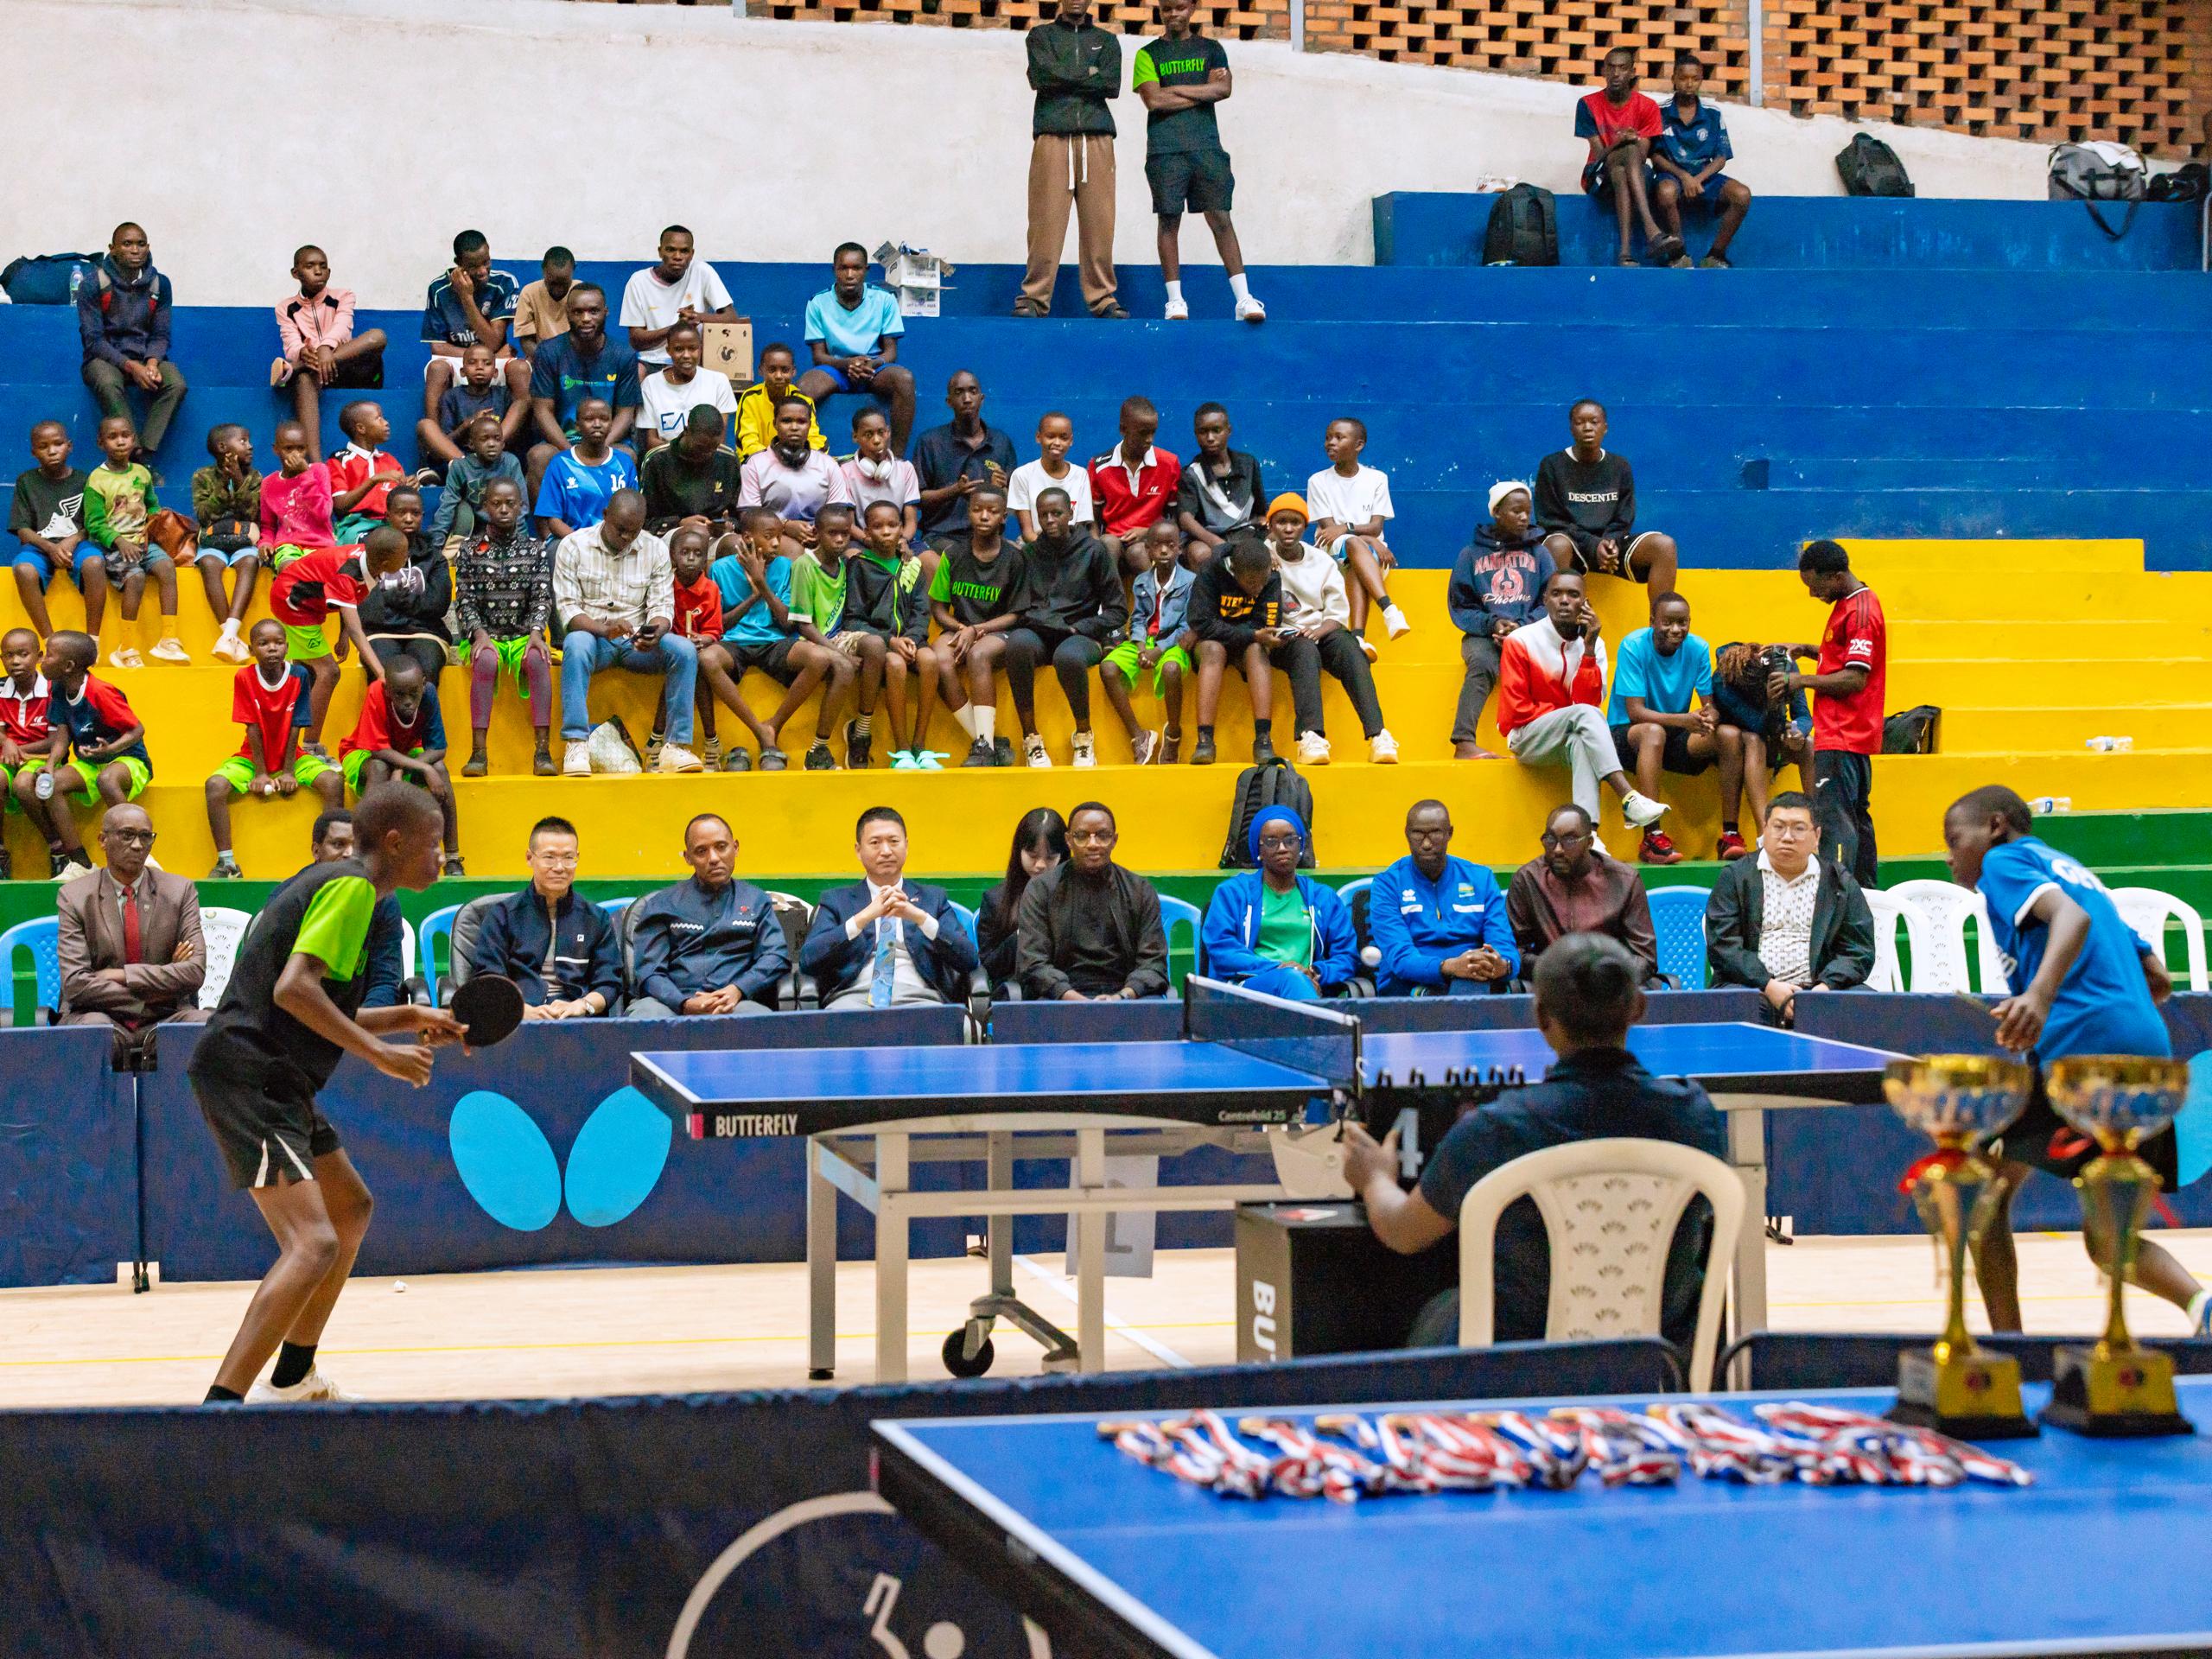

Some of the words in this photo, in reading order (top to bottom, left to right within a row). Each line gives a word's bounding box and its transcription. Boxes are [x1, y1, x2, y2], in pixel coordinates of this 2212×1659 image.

[1159, 58, 1205, 76] BUTTERFLY
[610, 474, 626, 492] 16
[1568, 492, 1618, 503] DESCENTE
[951, 581, 1001, 602] BUTTERFLY
[715, 1113, 798, 1138] BUTTERFLY
[1393, 1107, 1424, 1178] 4
[1252, 1280, 1277, 1363] BU
